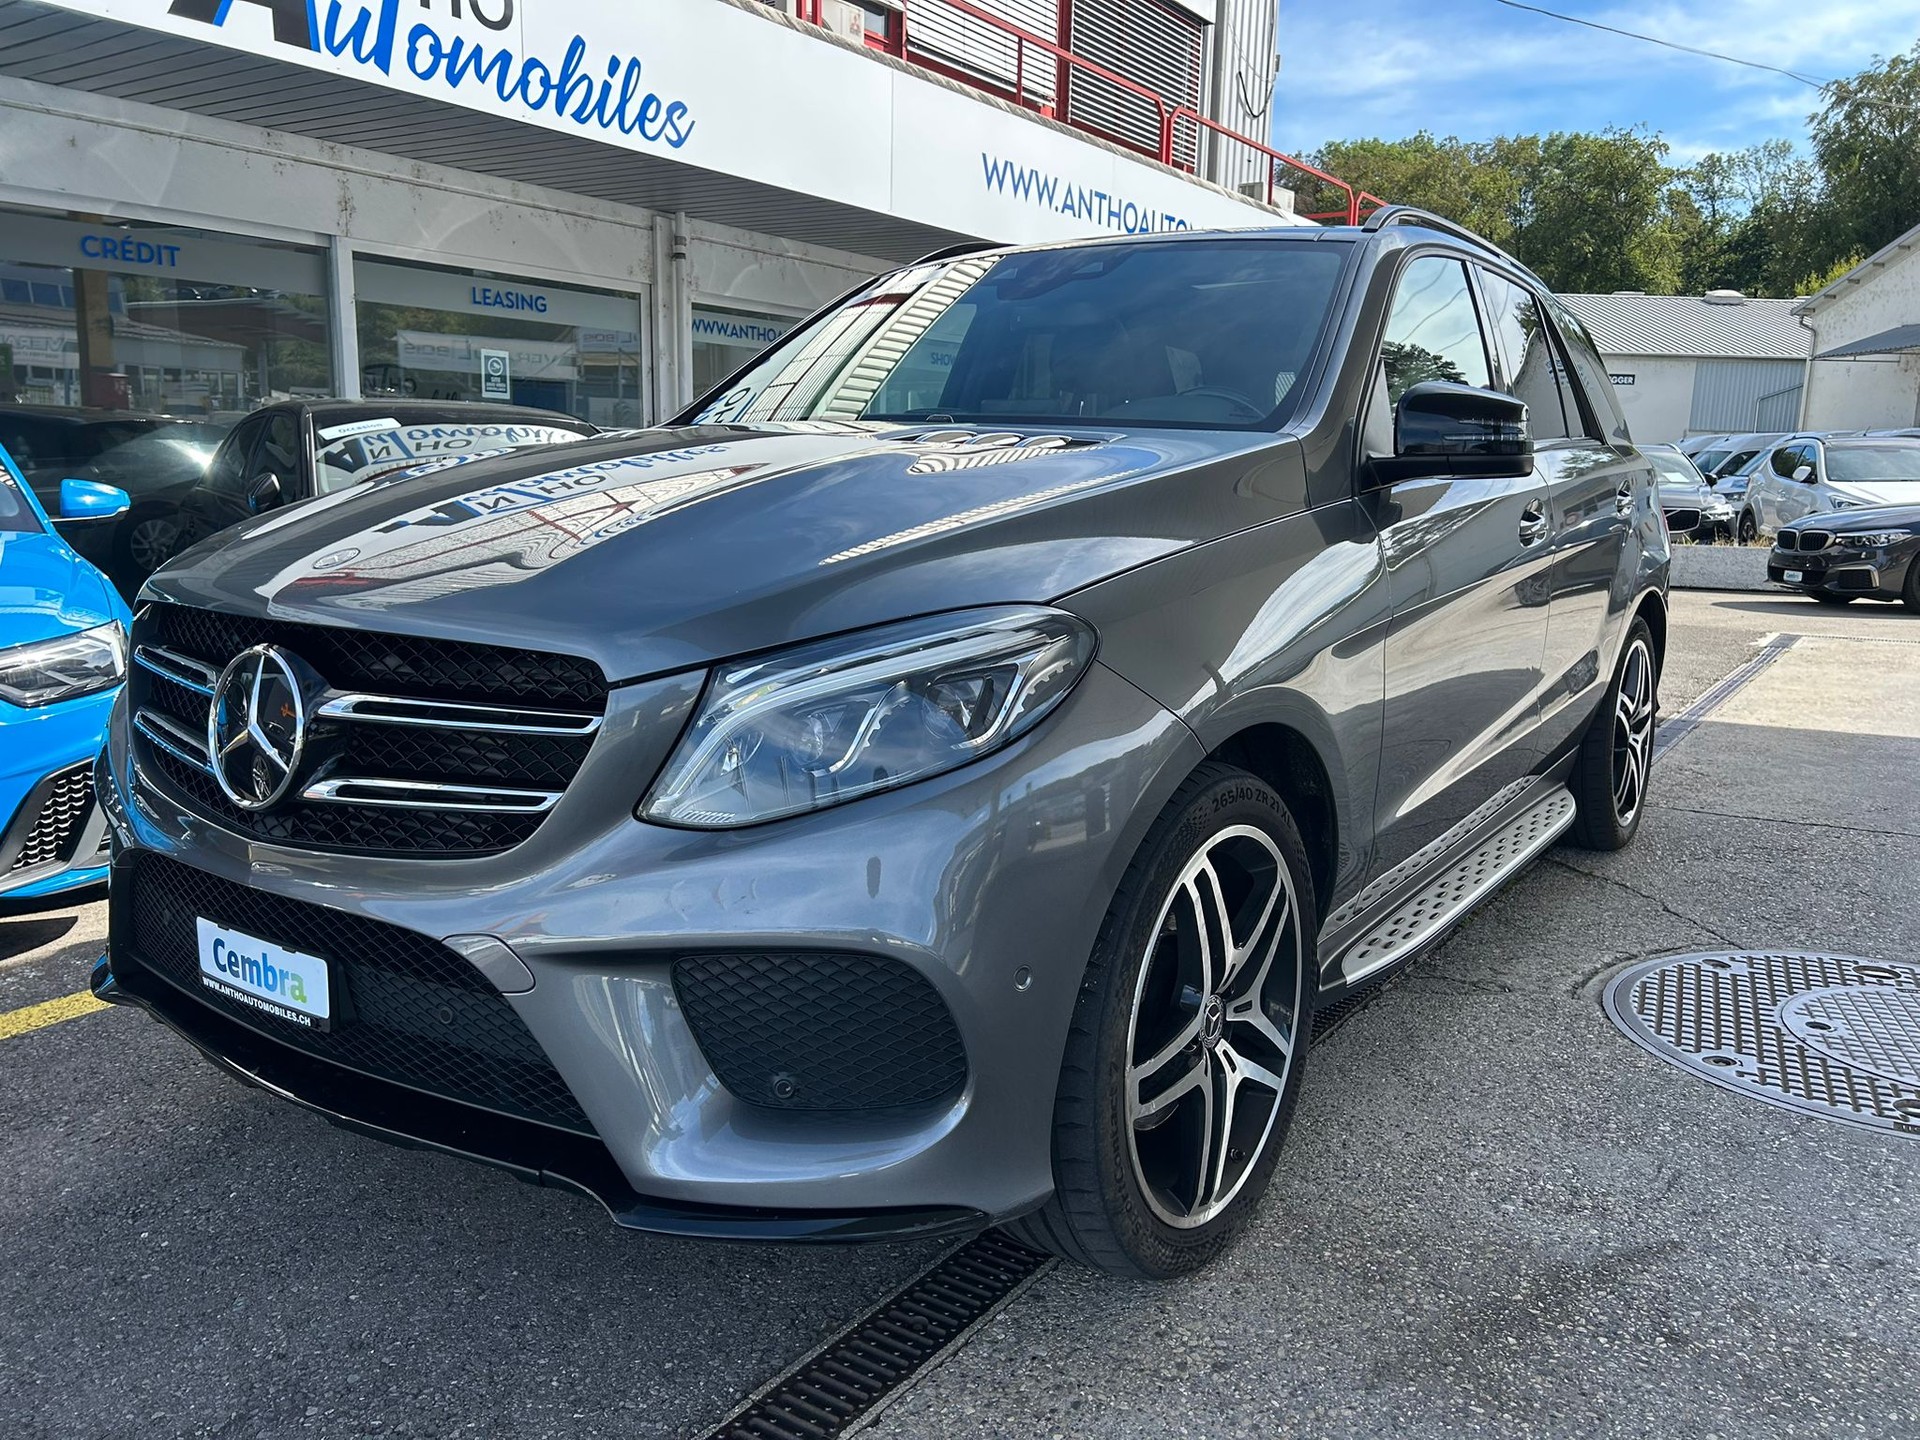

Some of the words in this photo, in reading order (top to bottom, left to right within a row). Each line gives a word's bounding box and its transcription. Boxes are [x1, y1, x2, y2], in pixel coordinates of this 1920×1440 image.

[981, 152, 1197, 234] WWW.ANTHOAUT
[80, 235, 181, 267] CRÉDIT
[471, 286, 548, 313] LEASING
[1609, 376, 1634, 384] GGER
[1211, 786, 1253, 814] 265/40
[1255, 788, 1269, 806] ZR
[1269, 796, 1280, 814] 21
[1281, 806, 1291, 829] XL
[213, 937, 308, 1004] Cembra
[202, 976, 312, 1027] WWW.ANTHOAUTOMOBILES.CH
